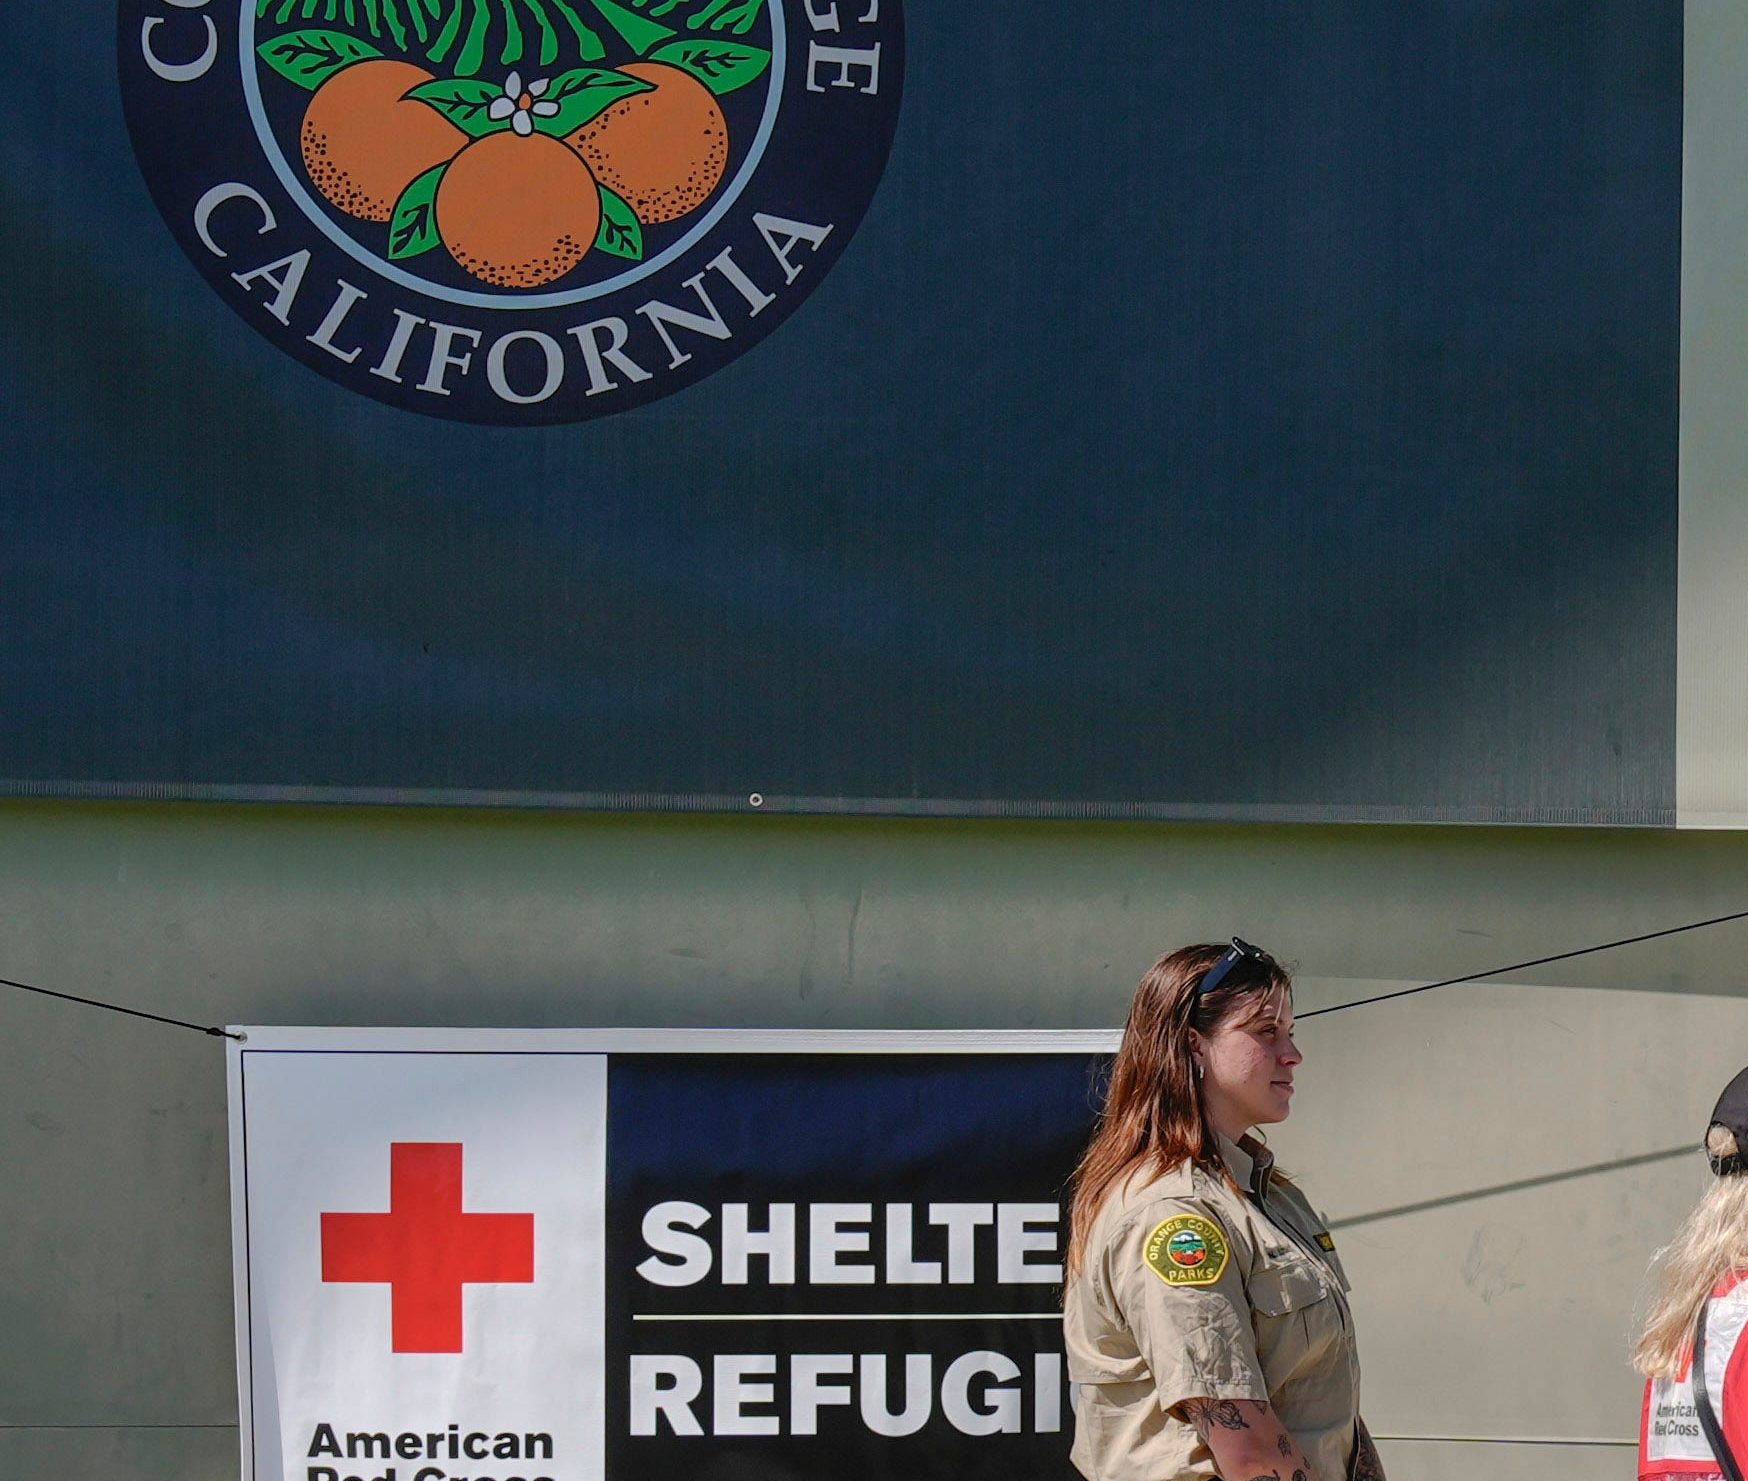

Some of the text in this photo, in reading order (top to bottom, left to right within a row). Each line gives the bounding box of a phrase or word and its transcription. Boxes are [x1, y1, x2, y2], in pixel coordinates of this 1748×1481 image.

[142, 0, 218, 82] C
[194, 182, 834, 405] CALIFORNIA
[636, 1201, 1064, 1287] SHELTE
[1149, 1220, 1183, 1260] ORANGE
[1169, 1268, 1214, 1281] PARKS
[630, 1350, 1078, 1437] REFUGI
[307, 1424, 554, 1461] American
[1667, 1420, 1699, 1437] Cross
